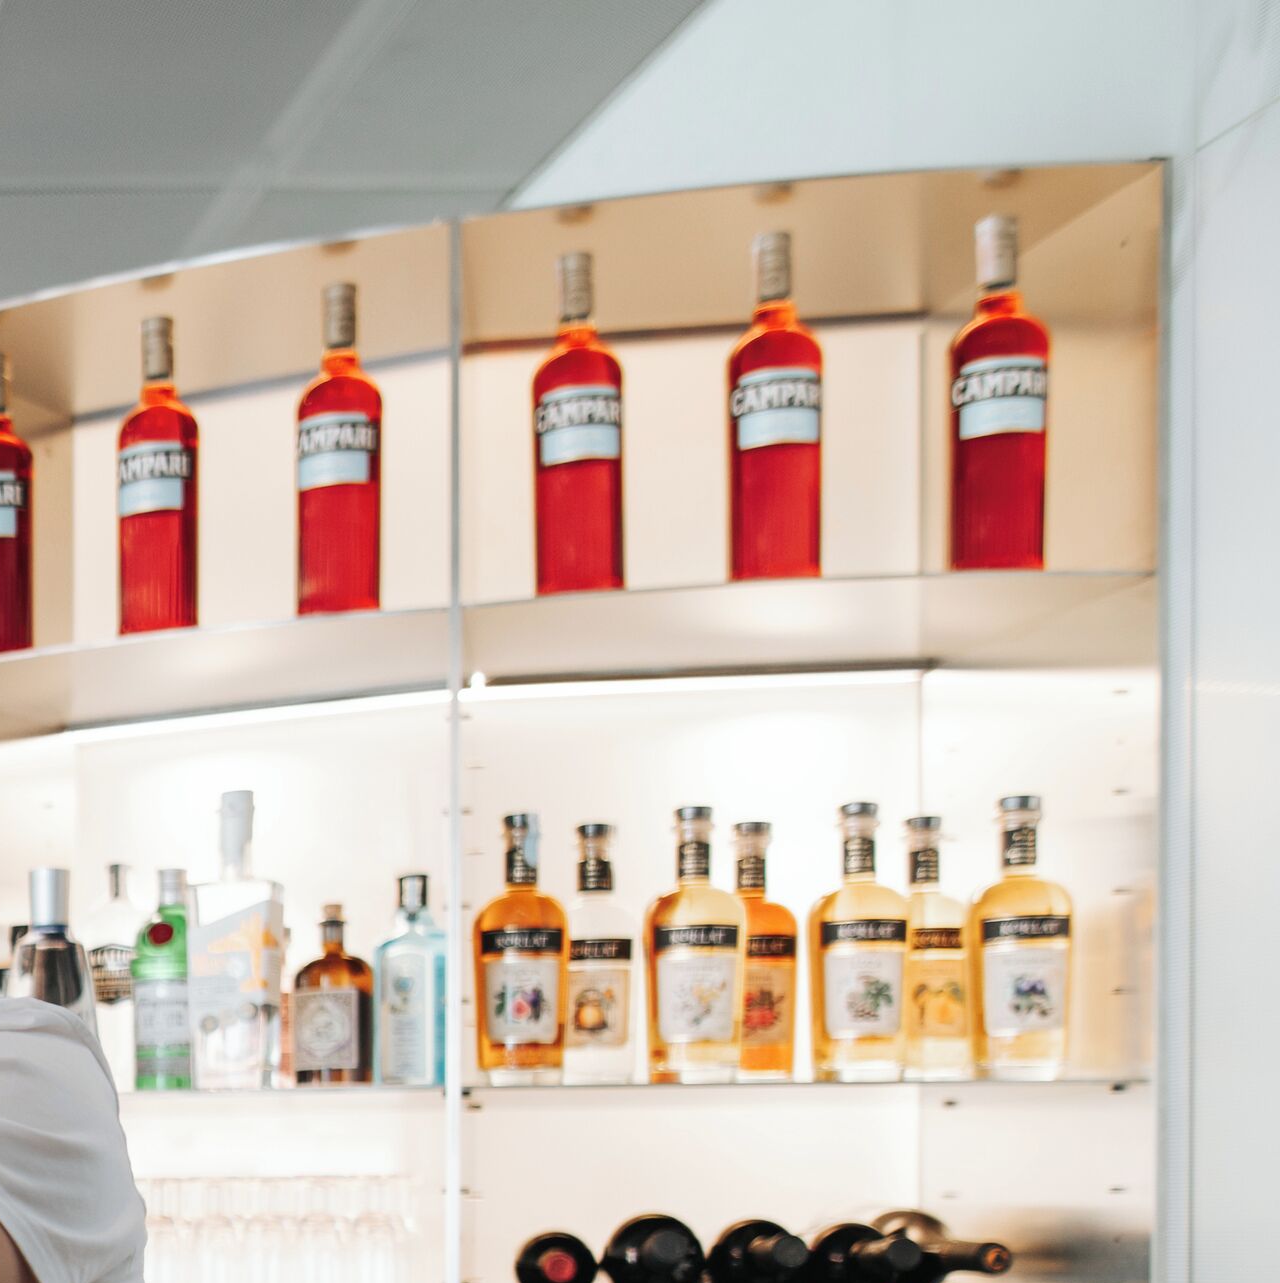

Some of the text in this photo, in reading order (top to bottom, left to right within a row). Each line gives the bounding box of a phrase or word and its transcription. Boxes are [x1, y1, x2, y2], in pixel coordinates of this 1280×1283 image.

[731, 380, 821, 417] CAMPAR
[951, 369, 1047, 407] CAMPAR
[535, 396, 620, 433] CAMPAR
[297, 422, 376, 454] AMPARI
[119, 451, 190, 485] AMPARI
